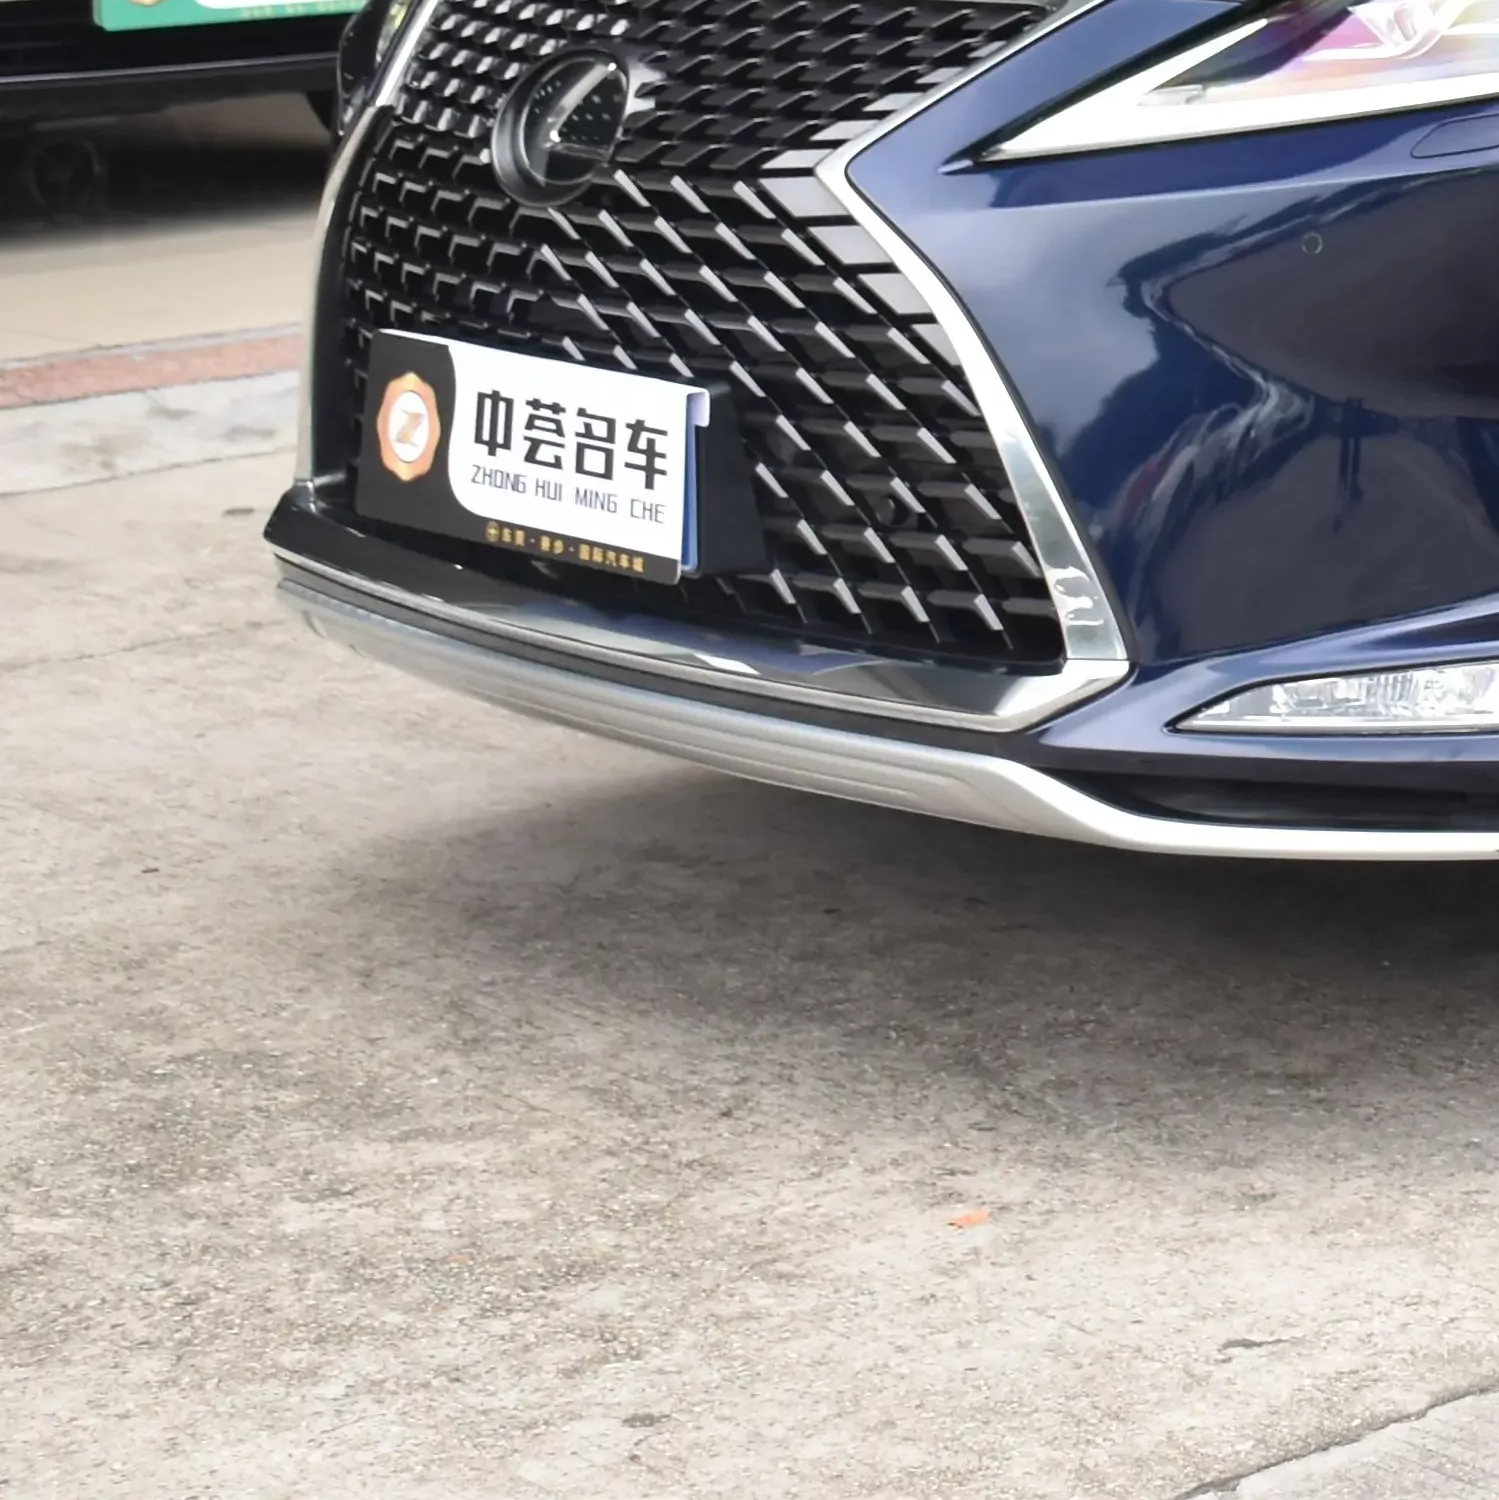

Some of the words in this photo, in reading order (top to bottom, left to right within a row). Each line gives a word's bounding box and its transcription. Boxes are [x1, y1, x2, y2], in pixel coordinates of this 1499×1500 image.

[473, 389, 668, 490] 中荟名车
[471, 463, 527, 495] ZHONG
[534, 477, 563, 503] HUI
[574, 486, 618, 514] MING
[630, 497, 667, 525] CHE
